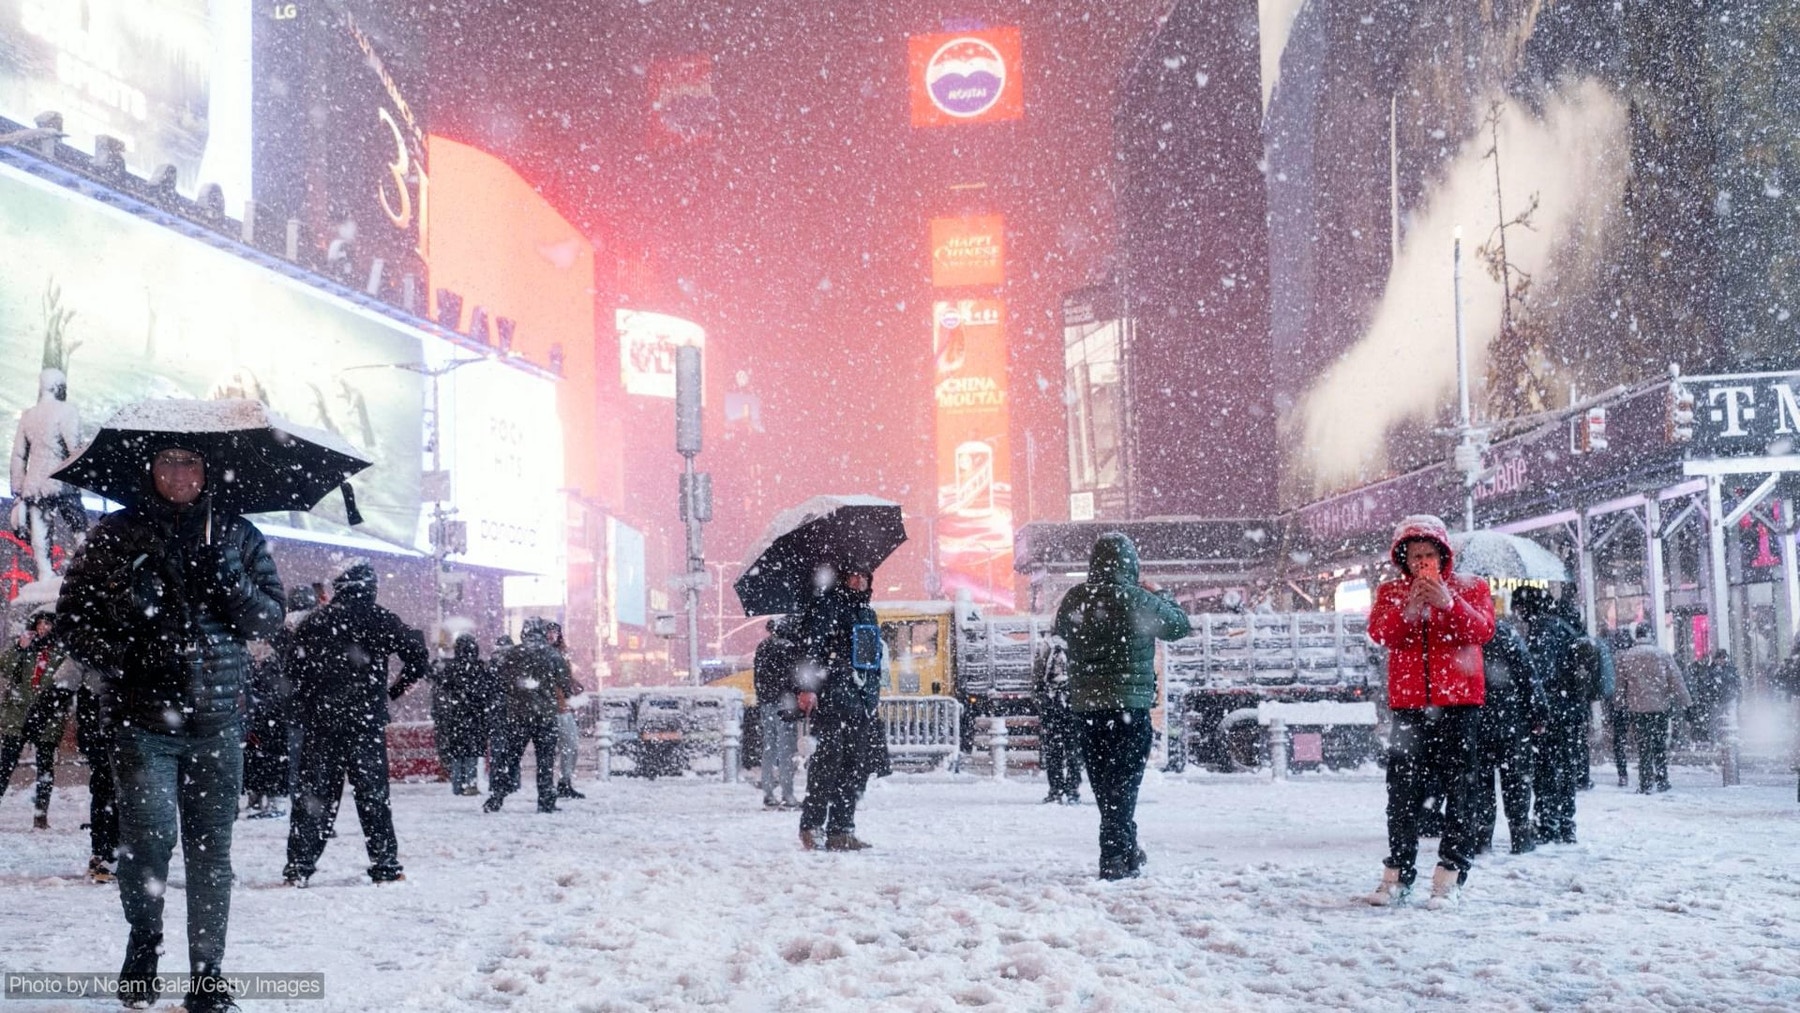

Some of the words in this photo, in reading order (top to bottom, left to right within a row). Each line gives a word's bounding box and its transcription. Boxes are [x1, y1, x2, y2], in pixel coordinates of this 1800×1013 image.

[275, 4, 297, 20] LG
[948, 88, 987, 101] MOUTAI
[948, 235, 990, 247] HAPPY
[934, 245, 999, 259] CHINESE
[943, 376, 996, 393] CHINA
[939, 391, 1005, 408] MOUTAI
[1708, 386, 1756, 437] T
